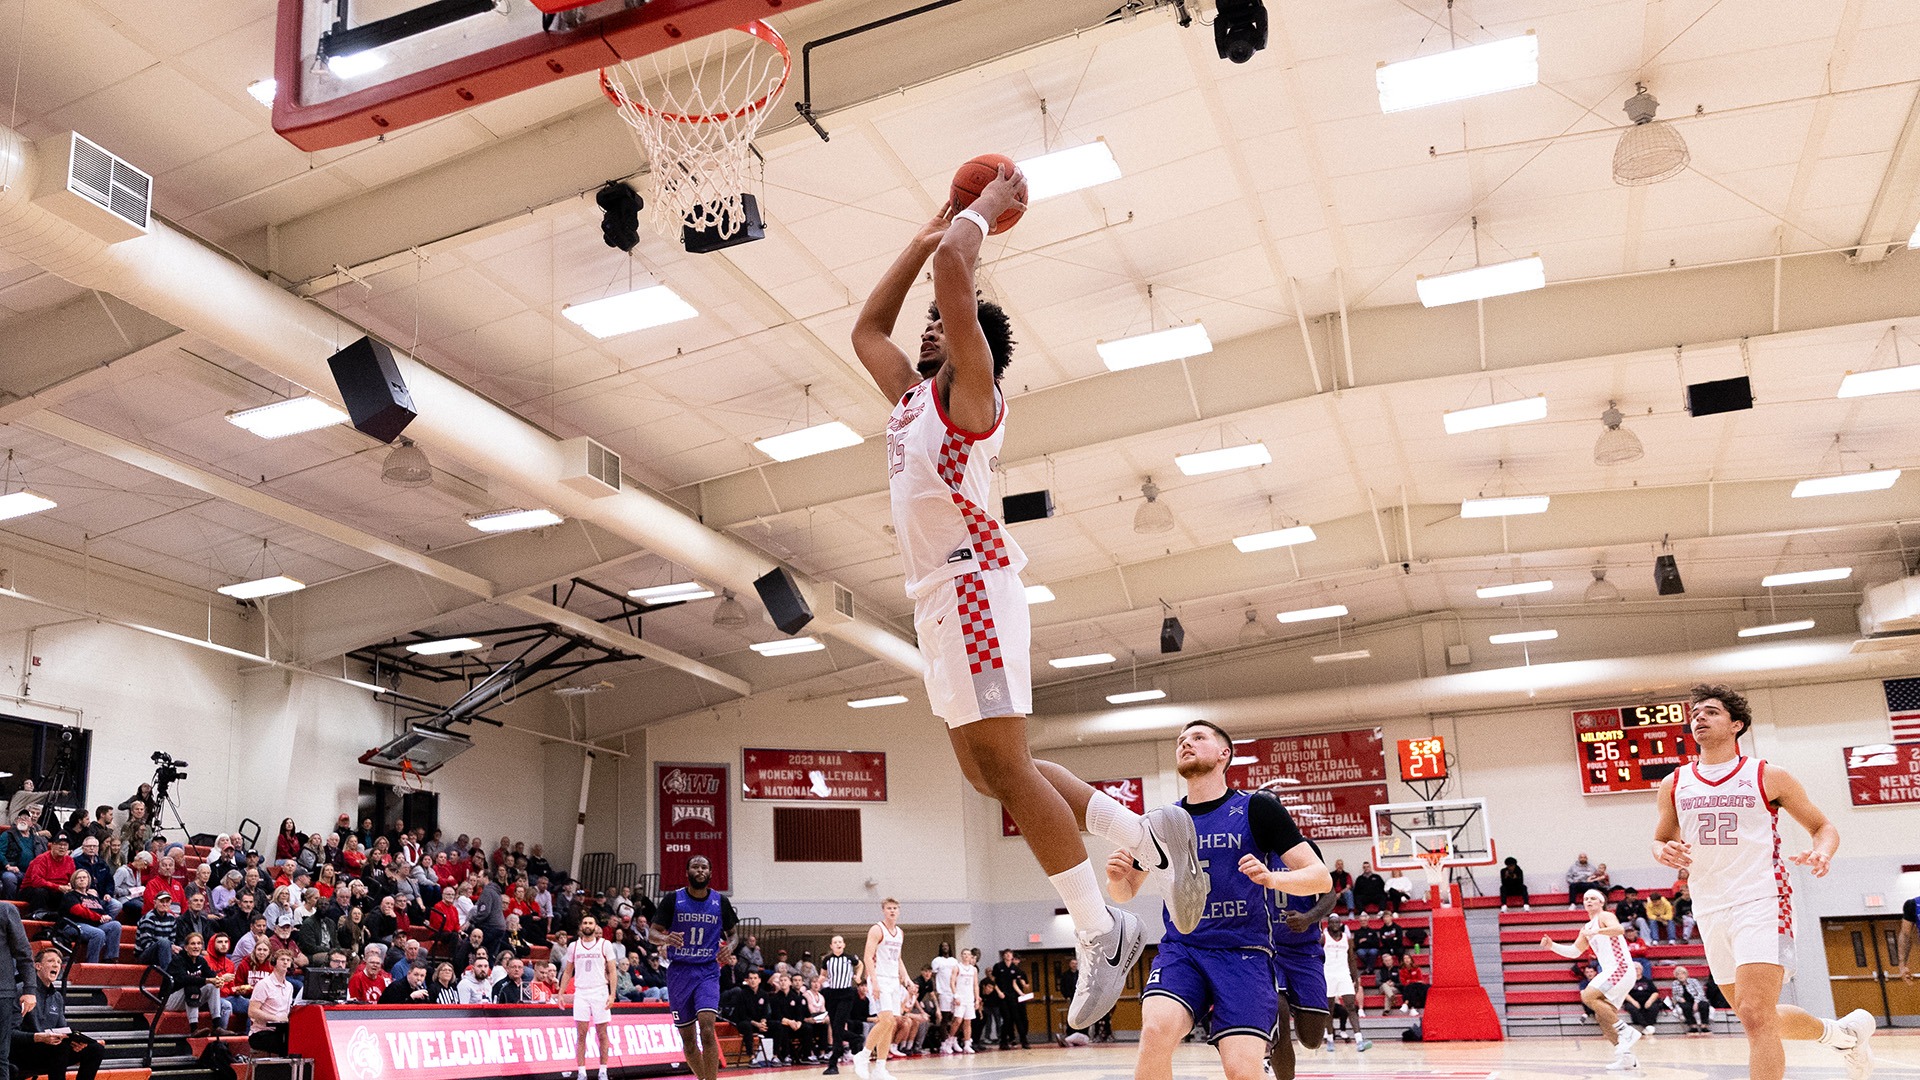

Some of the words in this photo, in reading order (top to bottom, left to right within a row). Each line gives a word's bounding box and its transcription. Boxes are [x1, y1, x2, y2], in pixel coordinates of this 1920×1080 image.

[1635, 703, 1684, 726] 5:28
[1580, 729, 1625, 742] WILDCATS
[1273, 741, 1298, 753] 2016
[1303, 738, 1330, 750] NAIA
[1409, 739, 1442, 756] 5:28
[1593, 741, 1621, 761] 36
[1656, 740, 1664, 754] 1
[788, 754, 815, 765] 2023
[819, 755, 843, 765] NAIA
[1270, 749, 1318, 764] DIVISION
[1638, 757, 1664, 766] PLAYER
[1248, 763, 1280, 777] MEN'S
[1285, 757, 1359, 773] BASKETBALL
[1409, 753, 1439, 777] 27
[758, 769, 804, 780] WOMEN'S
[1305, 768, 1363, 783] CHAMPION
[1595, 769, 1607, 783] 4
[1618, 767, 1631, 781] 4
[764, 785, 814, 797] NATIONAL
[1307, 791, 1333, 802] NAIA
[1879, 786, 1920, 801] NATIO
[1679, 794, 1757, 812] WILDCATS
[673, 806, 713, 822] NAIA
[664, 831, 691, 840] ELITE
[694, 831, 723, 840] EIGHT
[1310, 823, 1368, 838] CHAMPION
[1697, 812, 1739, 846] 22
[665, 843, 691, 853] 2019
[1198, 832, 1242, 850] HEN
[677, 912, 719, 925] GOSHEN
[689, 926, 705, 946] 11
[674, 946, 714, 957] COLLEGE
[384, 1028, 520, 1070] WELCOME
[515, 1026, 548, 1063] TO
[623, 1023, 684, 1056] ARENA
